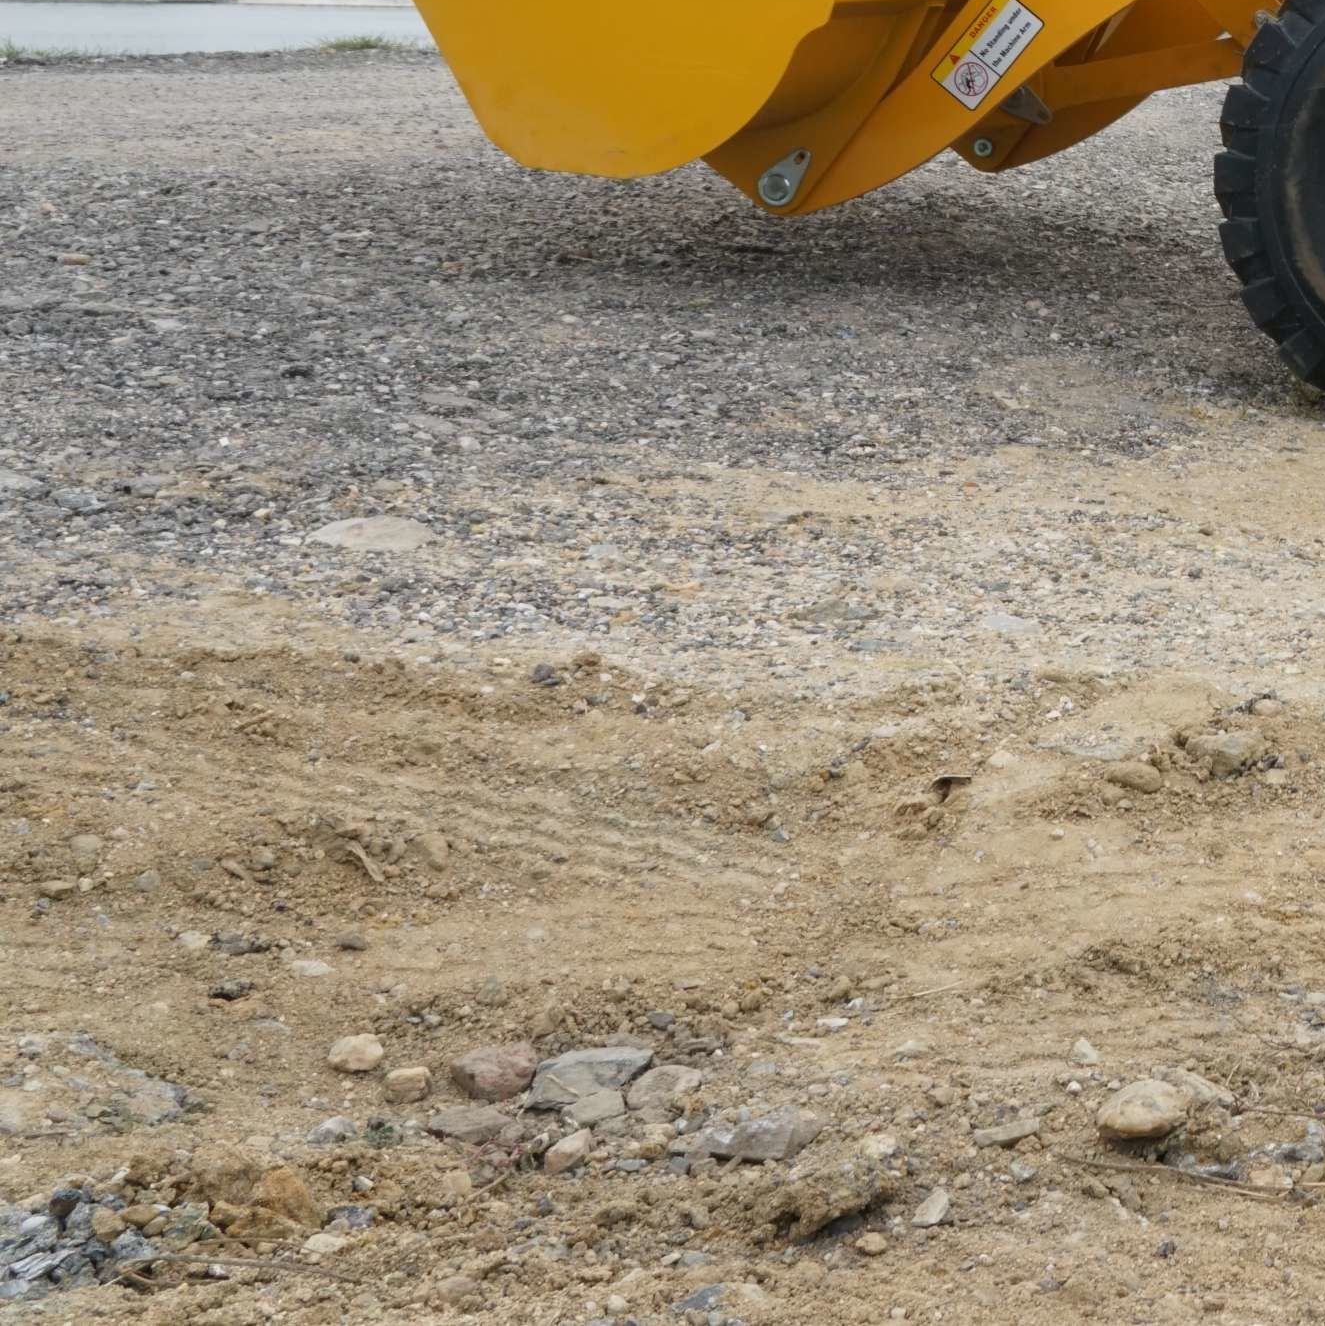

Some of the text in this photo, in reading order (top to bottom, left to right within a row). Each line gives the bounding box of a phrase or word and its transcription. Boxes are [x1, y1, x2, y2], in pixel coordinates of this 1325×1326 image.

[969, 6, 998, 39] DANGER
[979, 7, 1022, 58] No Standing under
[991, 21, 1032, 68] the Machine Arm
